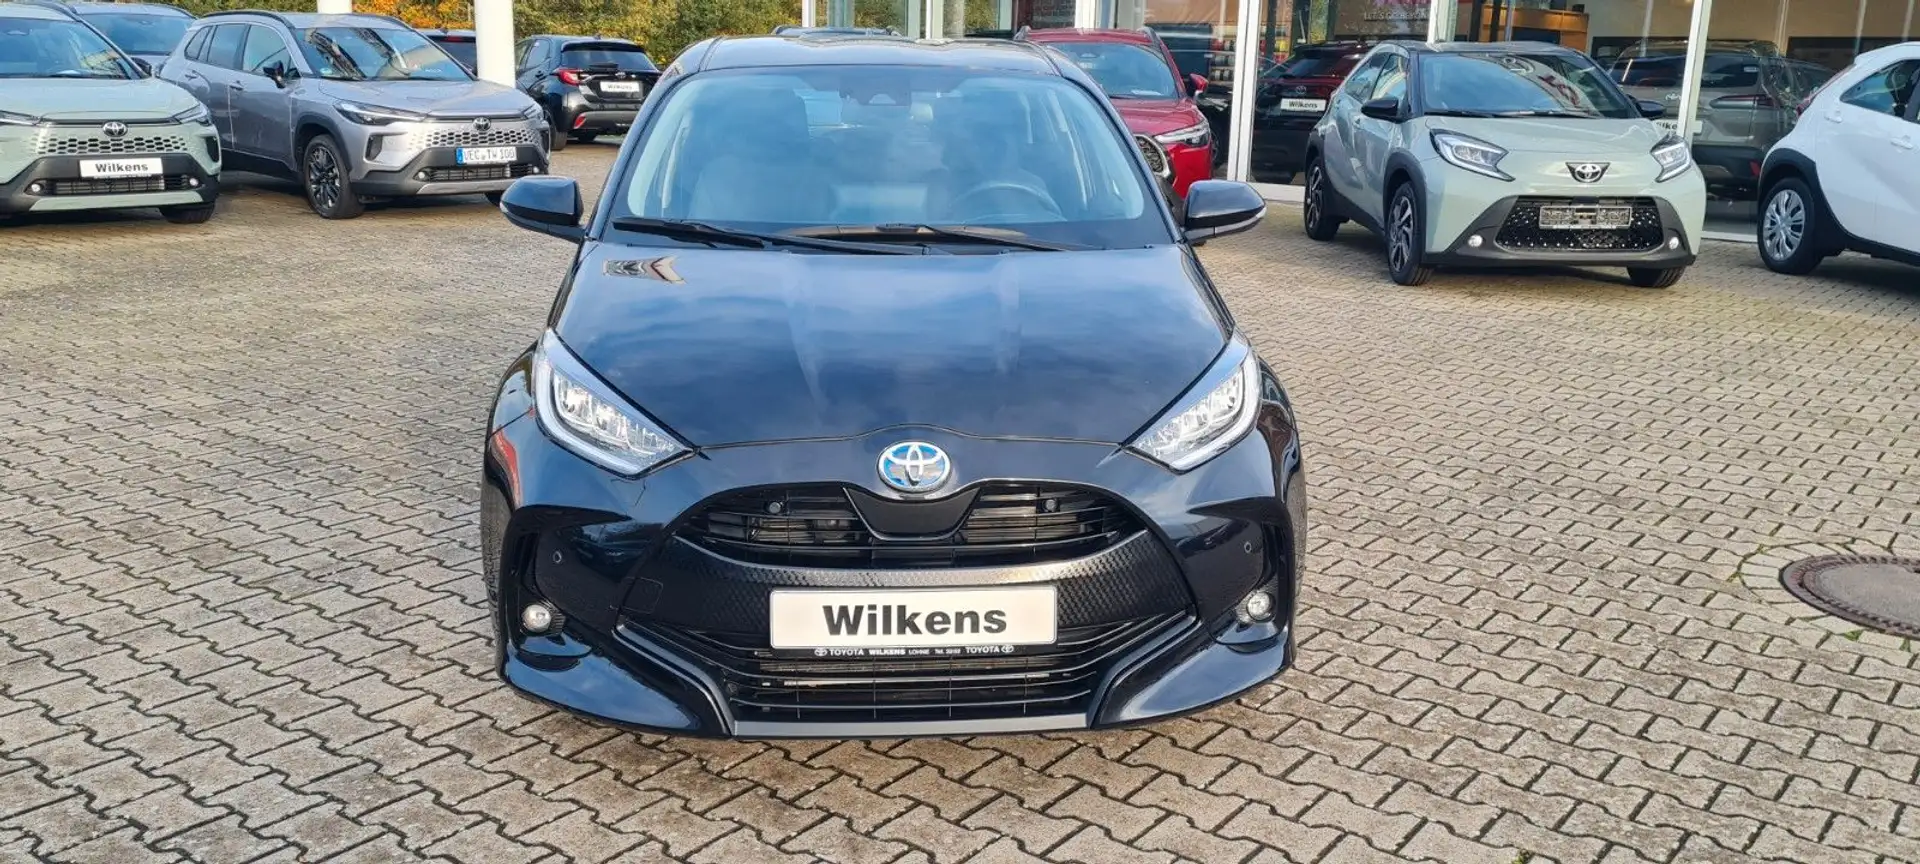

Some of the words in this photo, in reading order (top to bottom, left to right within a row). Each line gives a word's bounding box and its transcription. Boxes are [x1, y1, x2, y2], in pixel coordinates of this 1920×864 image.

[1289, 100, 1318, 108] Wilkens
[95, 163, 149, 173] Wilkens
[822, 604, 1007, 636] Wilkens
[829, 648, 865, 656] TOYOTA
[869, 648, 906, 656] WILKENS
[966, 645, 1000, 654] TOYOTA
